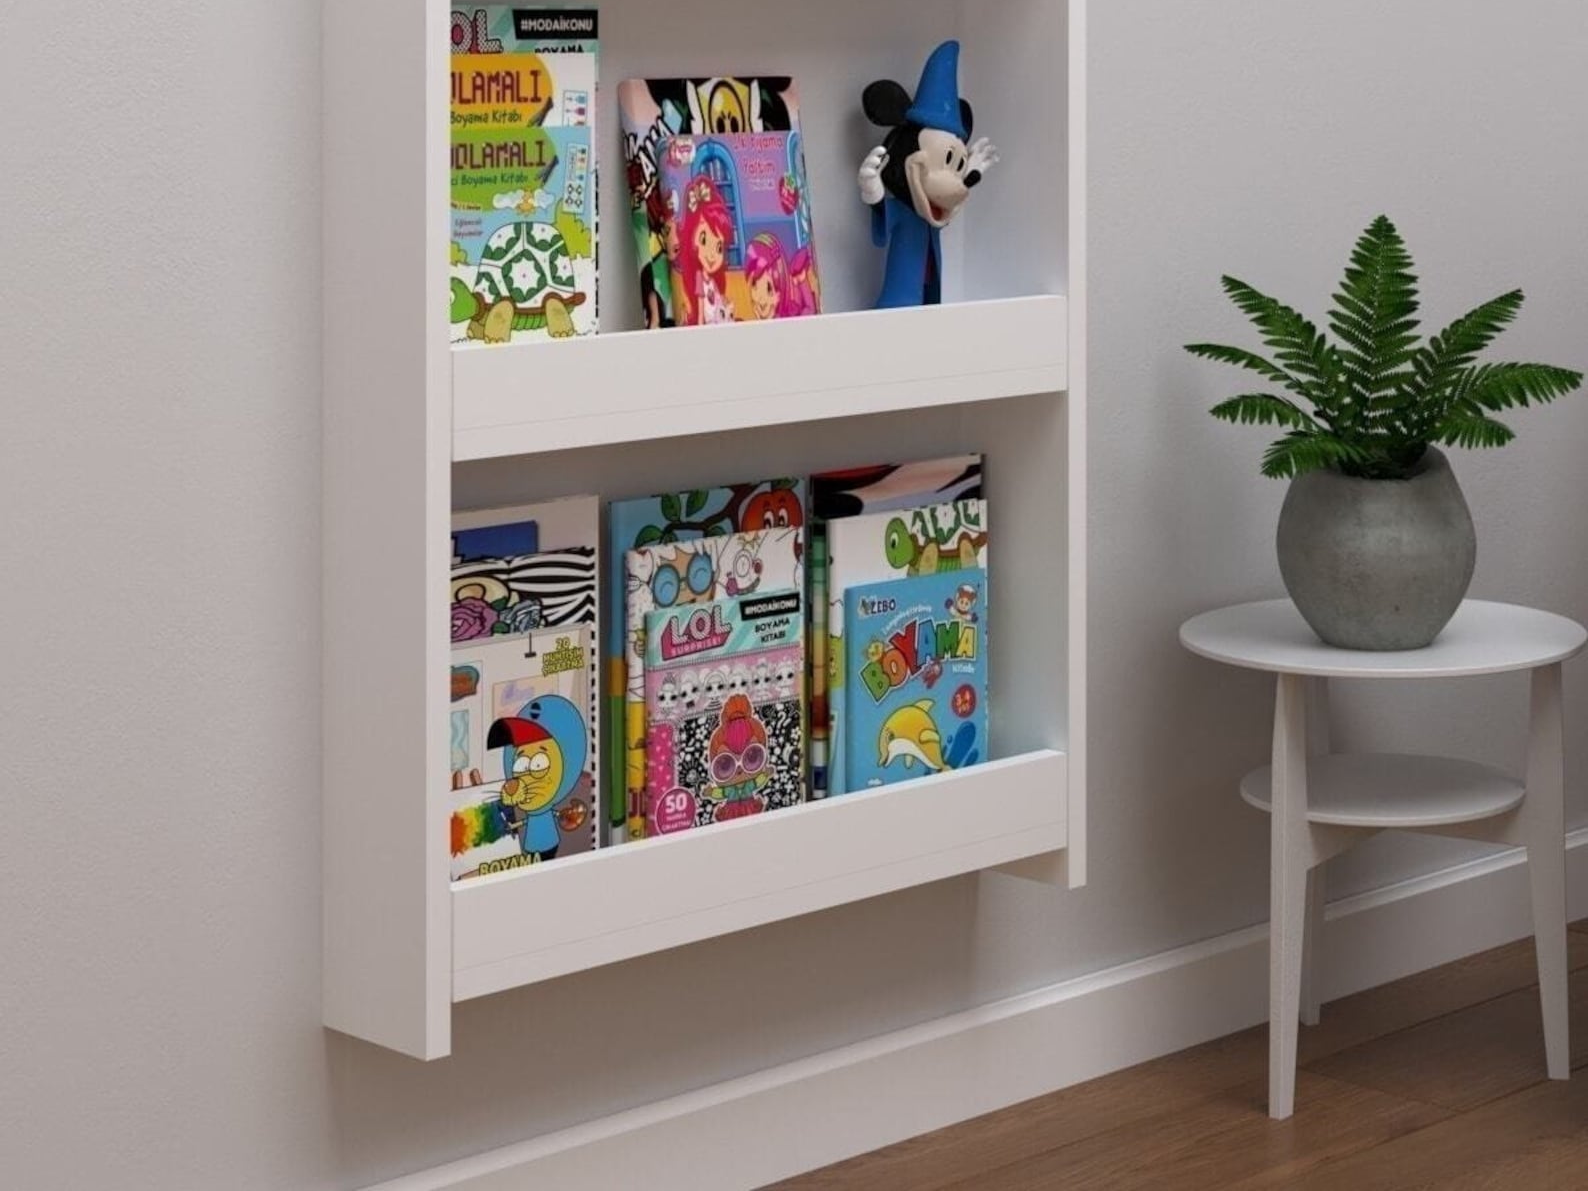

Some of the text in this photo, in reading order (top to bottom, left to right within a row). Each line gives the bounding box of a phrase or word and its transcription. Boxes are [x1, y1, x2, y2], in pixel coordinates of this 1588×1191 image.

[669, 604, 733, 645] LOL
[860, 619, 976, 702] BOYAMA
[665, 792, 688, 814] 50
